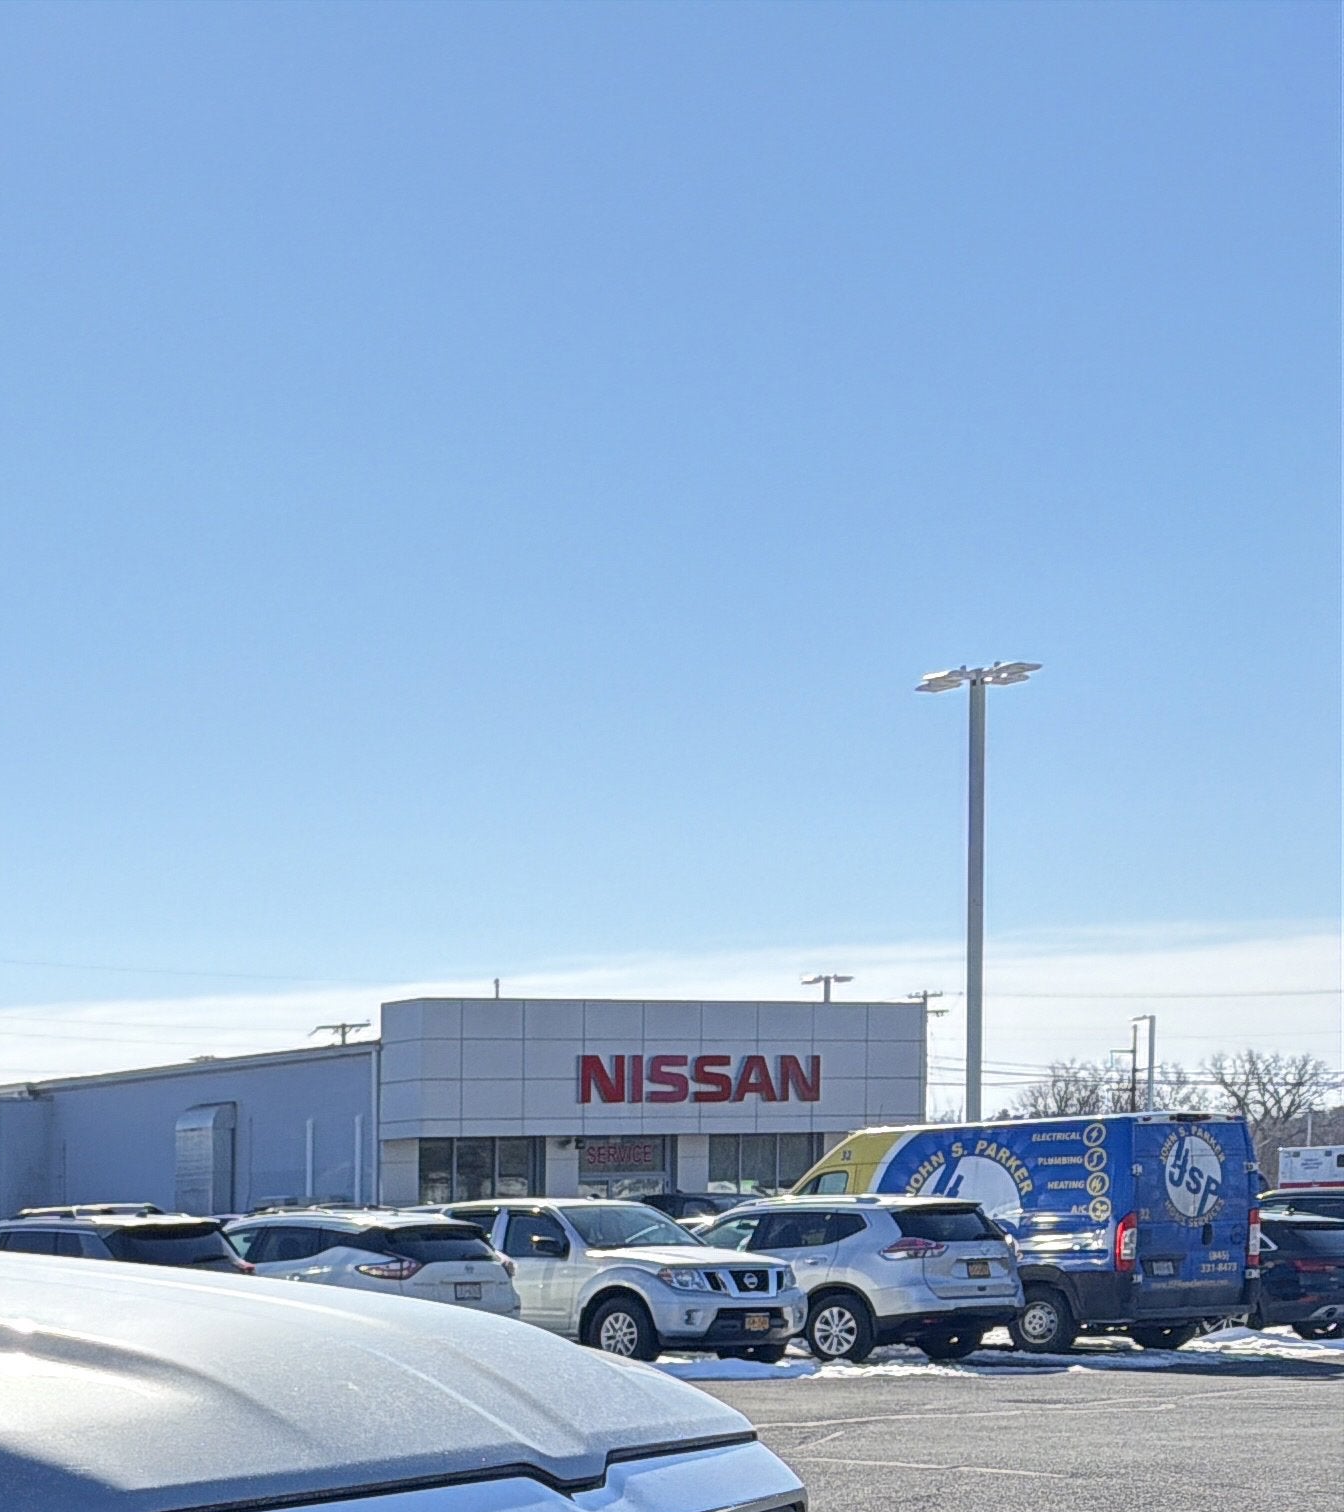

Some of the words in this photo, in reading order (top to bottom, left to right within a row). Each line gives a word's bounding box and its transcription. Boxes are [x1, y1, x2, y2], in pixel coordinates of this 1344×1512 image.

[577, 1053, 821, 1104] NISSAN
[1032, 1131, 1081, 1142] ELECTRICAL
[586, 1144, 653, 1165] SERVICE
[1038, 1156, 1083, 1166] PLUMBING
[905, 1150, 945, 1196] JOHN
[951, 1141, 968, 1158] S.
[975, 1140, 1033, 1196] PARKER
[1047, 1180, 1085, 1190] HEATING
